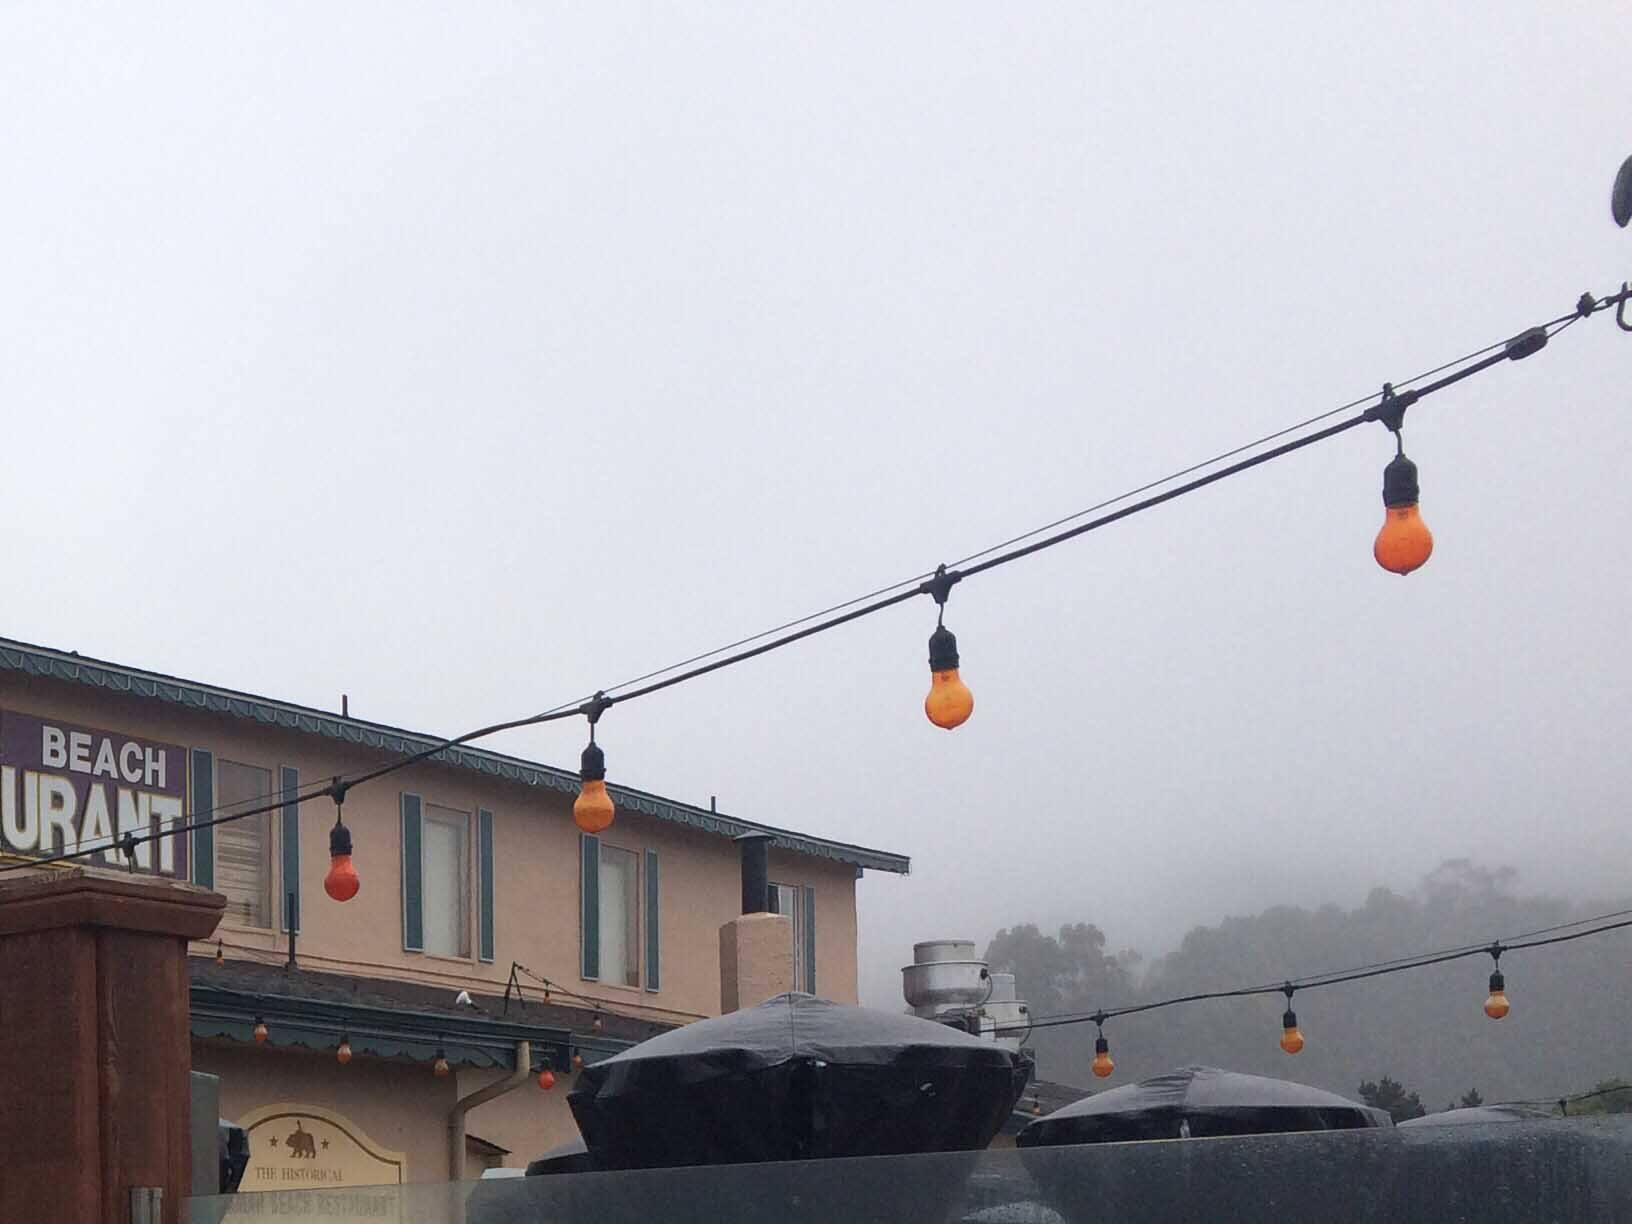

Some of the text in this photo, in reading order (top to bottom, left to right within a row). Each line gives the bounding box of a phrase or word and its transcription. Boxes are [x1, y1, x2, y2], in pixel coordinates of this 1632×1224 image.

[42, 725, 167, 788] BEACH
[255, 1167, 344, 1181] THE HISTORICAL
